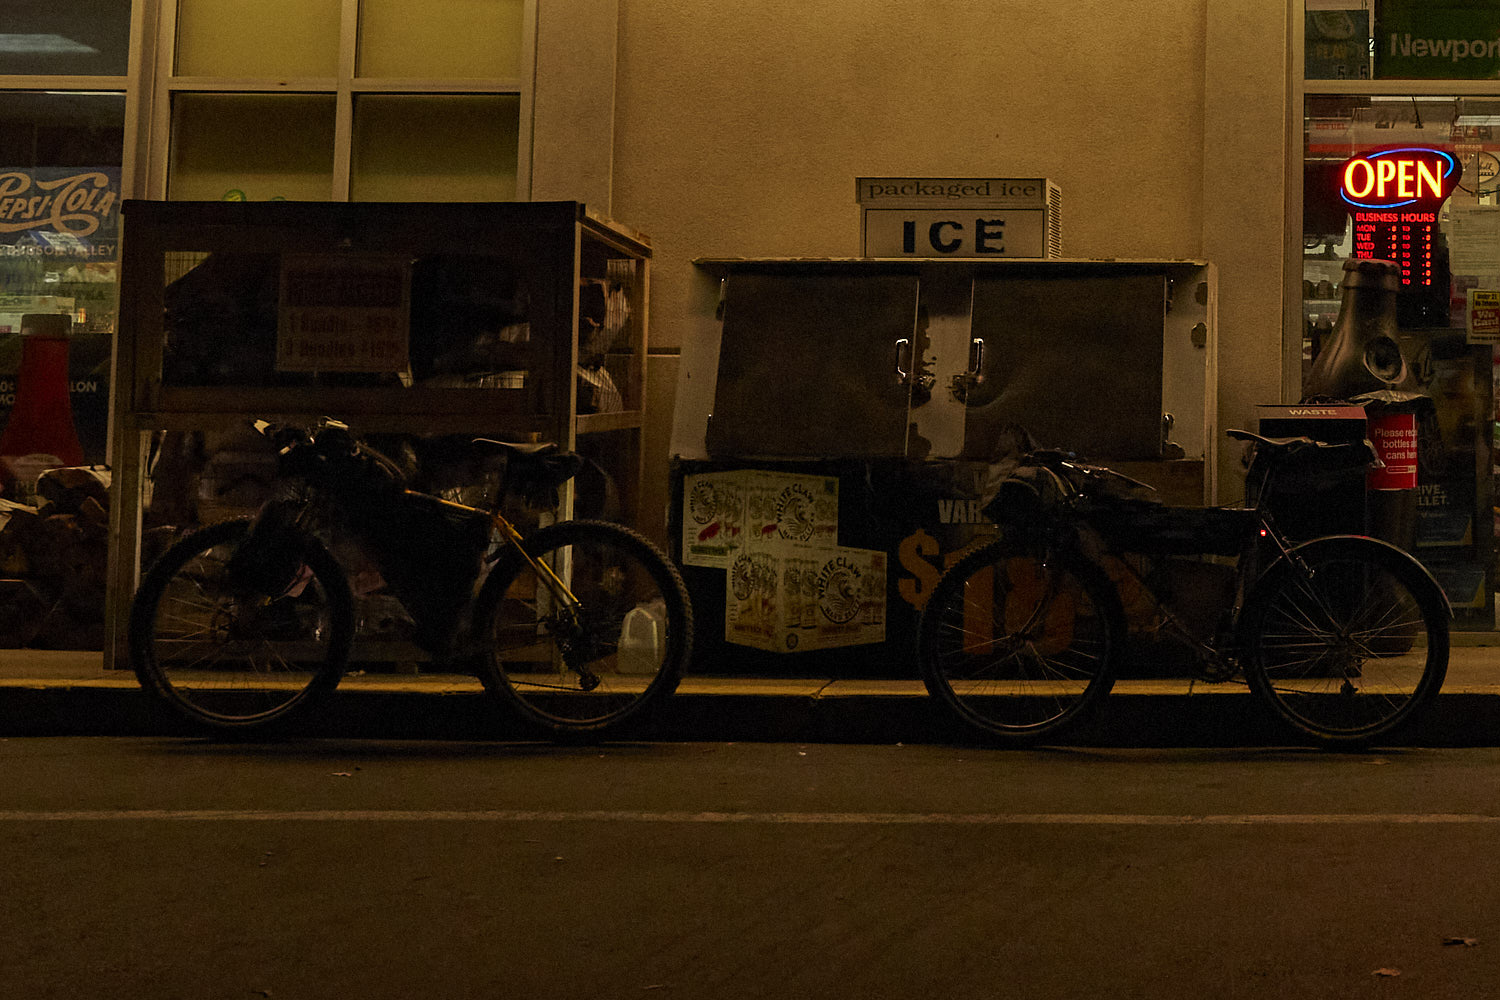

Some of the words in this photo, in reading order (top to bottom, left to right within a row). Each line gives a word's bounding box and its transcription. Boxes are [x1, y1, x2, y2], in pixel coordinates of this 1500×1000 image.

[1343, 159, 1443, 199] OPEN
[869, 182, 992, 199] packaged
[1002, 182, 1037, 197] ice
[1356, 212, 1399, 222] BUSINESS
[1401, 212, 1436, 222] HOURS
[1356, 224, 1376, 232] MON
[903, 218, 1005, 254] ICE
[1356, 233, 1371, 241] TUE
[1356, 242, 1375, 250] WED
[1356, 251, 1374, 259] THU
[1375, 429, 1404, 437] Please
[1383, 440, 1409, 449] bottles
[1386, 452, 1406, 460] cans
[793, 483, 815, 503] CLAW
[817, 560, 834, 600] WHITE
[835, 556, 862, 578] CLAW
